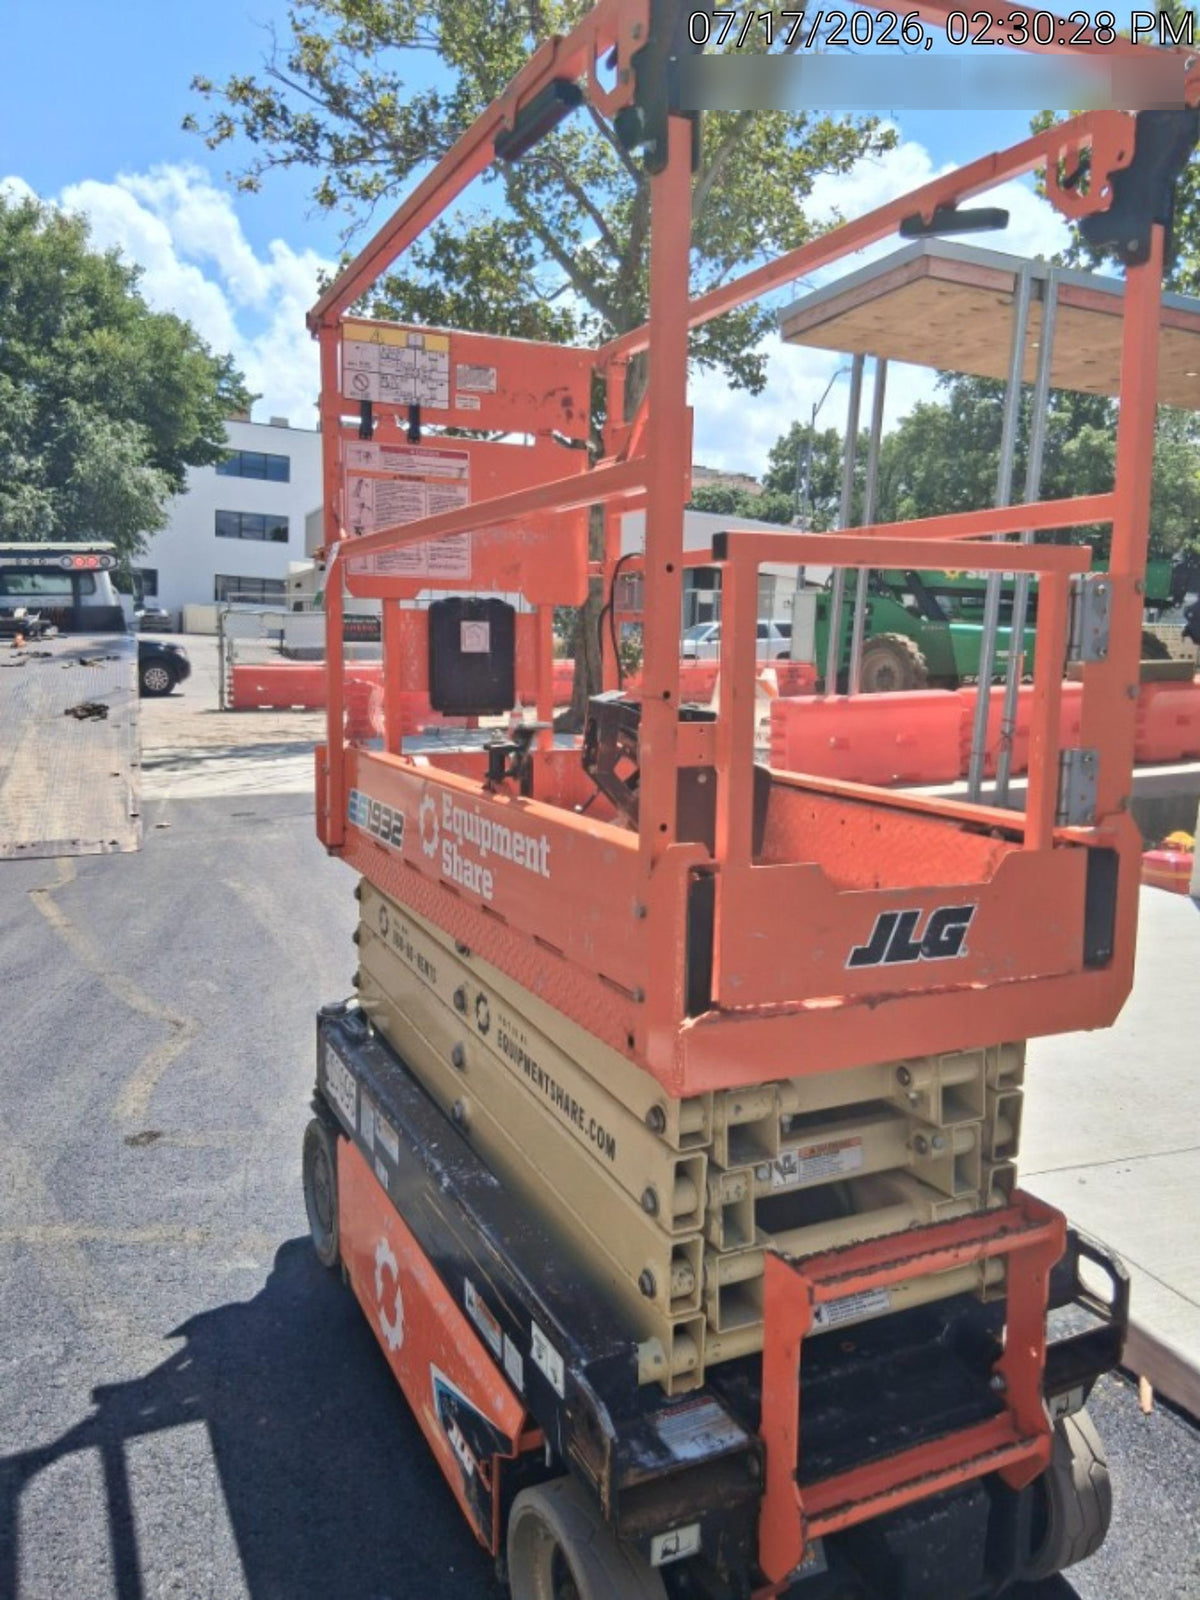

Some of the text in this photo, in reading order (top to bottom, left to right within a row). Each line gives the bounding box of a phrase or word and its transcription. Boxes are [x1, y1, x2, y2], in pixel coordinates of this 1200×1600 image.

[441, 793, 551, 879] Equipment
[441, 838, 493, 901] Share
[845, 903, 977, 969] JLG
[497, 1028, 617, 1162] EQUIPMENTSHARE.COM
